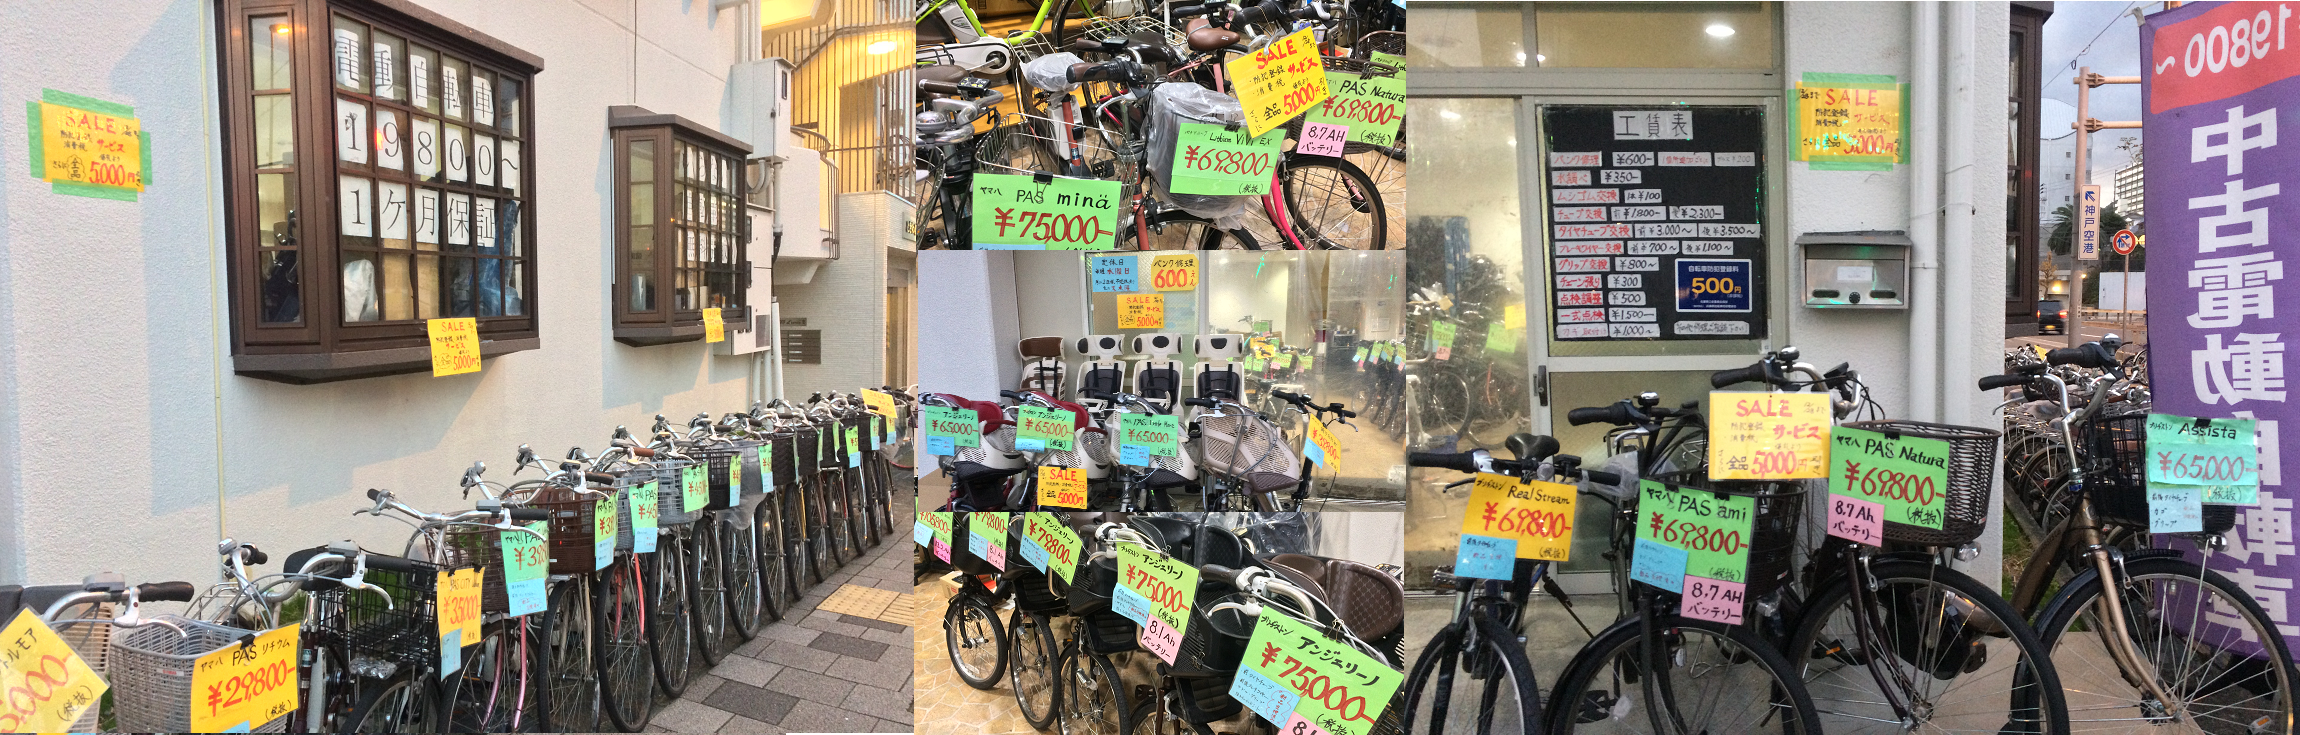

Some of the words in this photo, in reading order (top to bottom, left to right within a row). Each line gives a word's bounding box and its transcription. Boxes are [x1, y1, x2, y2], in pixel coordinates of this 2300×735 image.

[1255, 38, 1298, 70] SALE
[1287, 56, 1319, 79] サービス
[1339, 79, 1367, 96] PAS
[1370, 85, 1405, 104] Natura
[1824, 88, 1879, 106] SALE
[1263, 102, 1282, 121] 全品
[1854, 112, 1890, 125] サービス
[65, 109, 117, 135] SALE
[1615, 112, 1688, 138] 工賃表
[1360, 129, 1392, 146] (税抜)
[1301, 142, 1340, 155] バッテリー
[1184, 145, 1274, 177] ¥69,800-
[1553, 154, 1600, 166] パンク修理
[1615, 153, 1653, 165] ¥600-
[1556, 172, 1588, 184] 水調べ
[1604, 170, 1639, 183] ¥350-
[980, 185, 1003, 196] ヤマハ
[1016, 189, 1044, 204] PAS
[1057, 192, 1111, 210] minä
[1238, 183, 1264, 195] (税抜)
[1556, 190, 1617, 203] ムシゴム交換
[1556, 207, 1605, 221] チューブ交換
[1558, 225, 1631, 238] タイヤチューブ交換
[2082, 204, 2096, 254] 神戸空港
[1153, 258, 1195, 268] パンク修理
[1558, 258, 1608, 270] グリップ交換
[1154, 268, 1188, 289] 600
[1559, 276, 1600, 288] チェーン張り
[1612, 276, 1639, 287] ¥300
[1691, 277, 1742, 294] 500円
[1126, 296, 1151, 305] SALE
[1560, 292, 1602, 306] 点検調整
[1612, 293, 1641, 305] ¥500
[1560, 310, 1605, 321] 一式点検
[441, 321, 466, 333] SALE
[1736, 399, 1793, 418] SALE
[1772, 423, 1823, 440] サービス
[2177, 422, 2237, 440] Assista
[1836, 435, 1861, 448] ヤマハ
[1864, 438, 1896, 459] PAS
[1898, 446, 1946, 470] Natura
[1726, 455, 1749, 471] 全品
[1049, 468, 1077, 481] SALE
[1844, 459, 1946, 507] ¥69,800-
[1507, 485, 1535, 500] Real
[1534, 489, 1571, 505] Stream
[2207, 485, 2242, 503] (税抜)
[1646, 487, 1674, 502] ヤマハ
[1678, 495, 1712, 516] PAS
[1717, 506, 1747, 523] ami
[1906, 505, 1942, 529] (税抜)
[1650, 511, 1749, 556] ¥69,800-
[1832, 520, 1881, 541] バッテリー
[1539, 546, 1566, 559] (税抜)
[1142, 554, 1183, 580] アンジェリーノ
[1709, 567, 1741, 582] (税抜)
[1687, 601, 1742, 620] バッテリー
[232, 643, 257, 667] PAS
[262, 638, 290, 655] リチウム
[1143, 636, 1171, 658] バッテリー
[1297, 635, 1380, 686] アンジェリーノ
